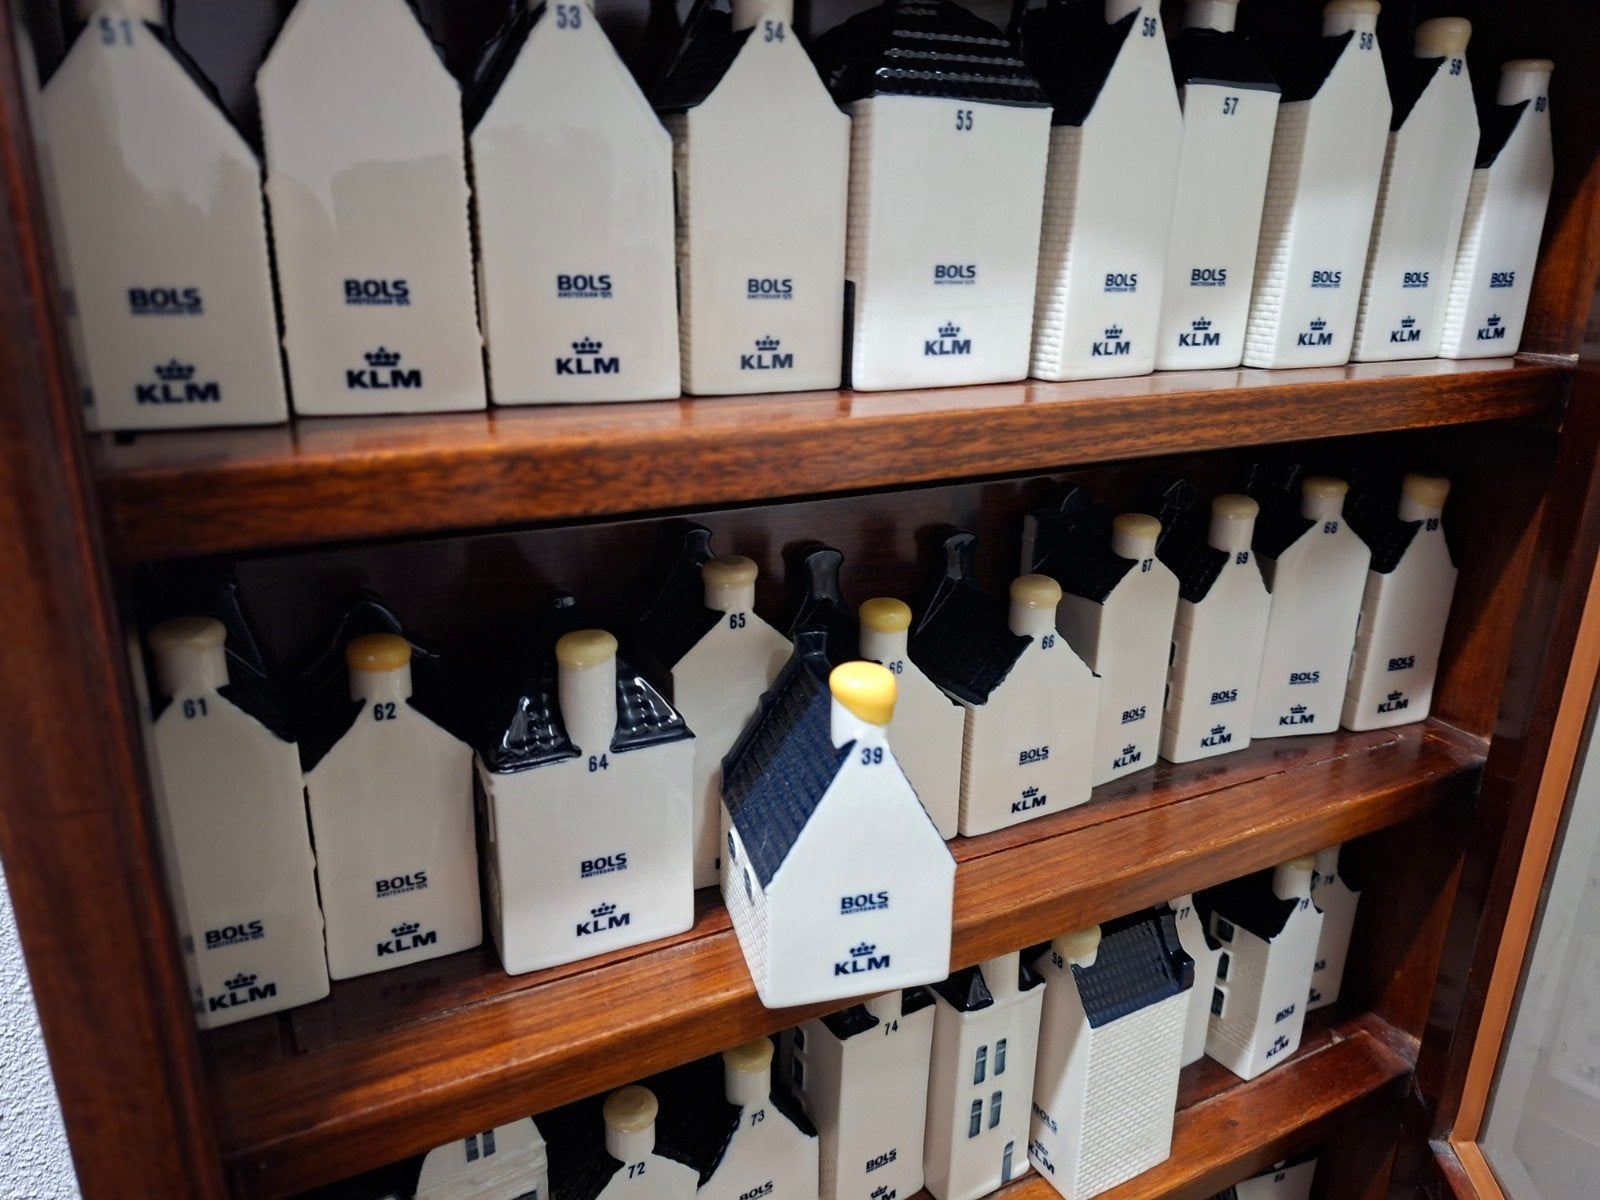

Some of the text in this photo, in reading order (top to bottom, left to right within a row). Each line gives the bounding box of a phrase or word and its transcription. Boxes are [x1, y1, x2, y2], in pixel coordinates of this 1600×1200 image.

[556, 5, 581, 29] 53
[100, 17, 134, 47] 51
[764, 21, 785, 43] 54
[1142, 18, 1157, 38] 56
[1359, 32, 1373, 50] 58
[1449, 59, 1463, 76] 59
[1222, 97, 1239, 115] 57
[956, 110, 973, 131] 55
[935, 265, 975, 278] BOLS
[1106, 274, 1137, 287] BOLS
[1192, 269, 1226, 281] BOLS
[1312, 271, 1341, 283] BOLS
[1404, 272, 1429, 284] BOLS
[1491, 272, 1514, 284] BOLS
[345, 279, 408, 298] BOLS
[558, 275, 612, 291] BOLS
[748, 279, 792, 293] BOLS
[128, 288, 201, 308] BOLS
[1178, 332, 1220, 347] KLM
[1297, 332, 1332, 346] KLM
[1390, 329, 1421, 344] KLM
[1476, 326, 1505, 341] KLM
[924, 339, 971, 356] KLM
[1091, 341, 1130, 356] KLM
[556, 356, 620, 375] KLM
[740, 354, 793, 370] KLM
[346, 369, 422, 390] KLM
[136, 383, 220, 404] KLM
[1141, 558, 1153, 573] 67
[729, 612, 746, 630] 65
[1042, 634, 1054, 650] 66
[889, 660, 904, 676] 66
[1389, 656, 1414, 668] BOLS
[1290, 671, 1320, 682] BOLS
[1210, 688, 1237, 702] BOLS
[183, 698, 208, 720] 61
[374, 702, 397, 722] 62
[1122, 706, 1146, 721] BOLS
[1377, 698, 1408, 714] KLM
[1279, 714, 1314, 726] KLM
[1200, 734, 1231, 748] KLM
[862, 748, 883, 766] 39
[1019, 746, 1049, 762] BOLS
[1113, 752, 1141, 770] KLM
[588, 754, 610, 774] 64
[1011, 794, 1047, 814] KLM
[581, 852, 626, 874] BOLS
[376, 872, 428, 892] BOLS
[841, 891, 888, 910] BOLS
[1178, 906, 1190, 920] 77
[205, 920, 264, 944] BOLS
[576, 912, 630, 937] KLM
[376, 930, 437, 957] KLM
[834, 954, 891, 977] KLM
[1052, 952, 1064, 969] 58
[208, 982, 276, 1012] KLM
[884, 1019, 899, 1036] 74
[1266, 1038, 1290, 1058] KLM
[750, 1109, 765, 1127] 73
[1033, 1102, 1057, 1132] BOLS
[866, 1148, 896, 1170] BOLS
[1028, 1142, 1054, 1175] KLM
[628, 1161, 646, 1179] 72
[740, 1180, 773, 1200] BOLS
